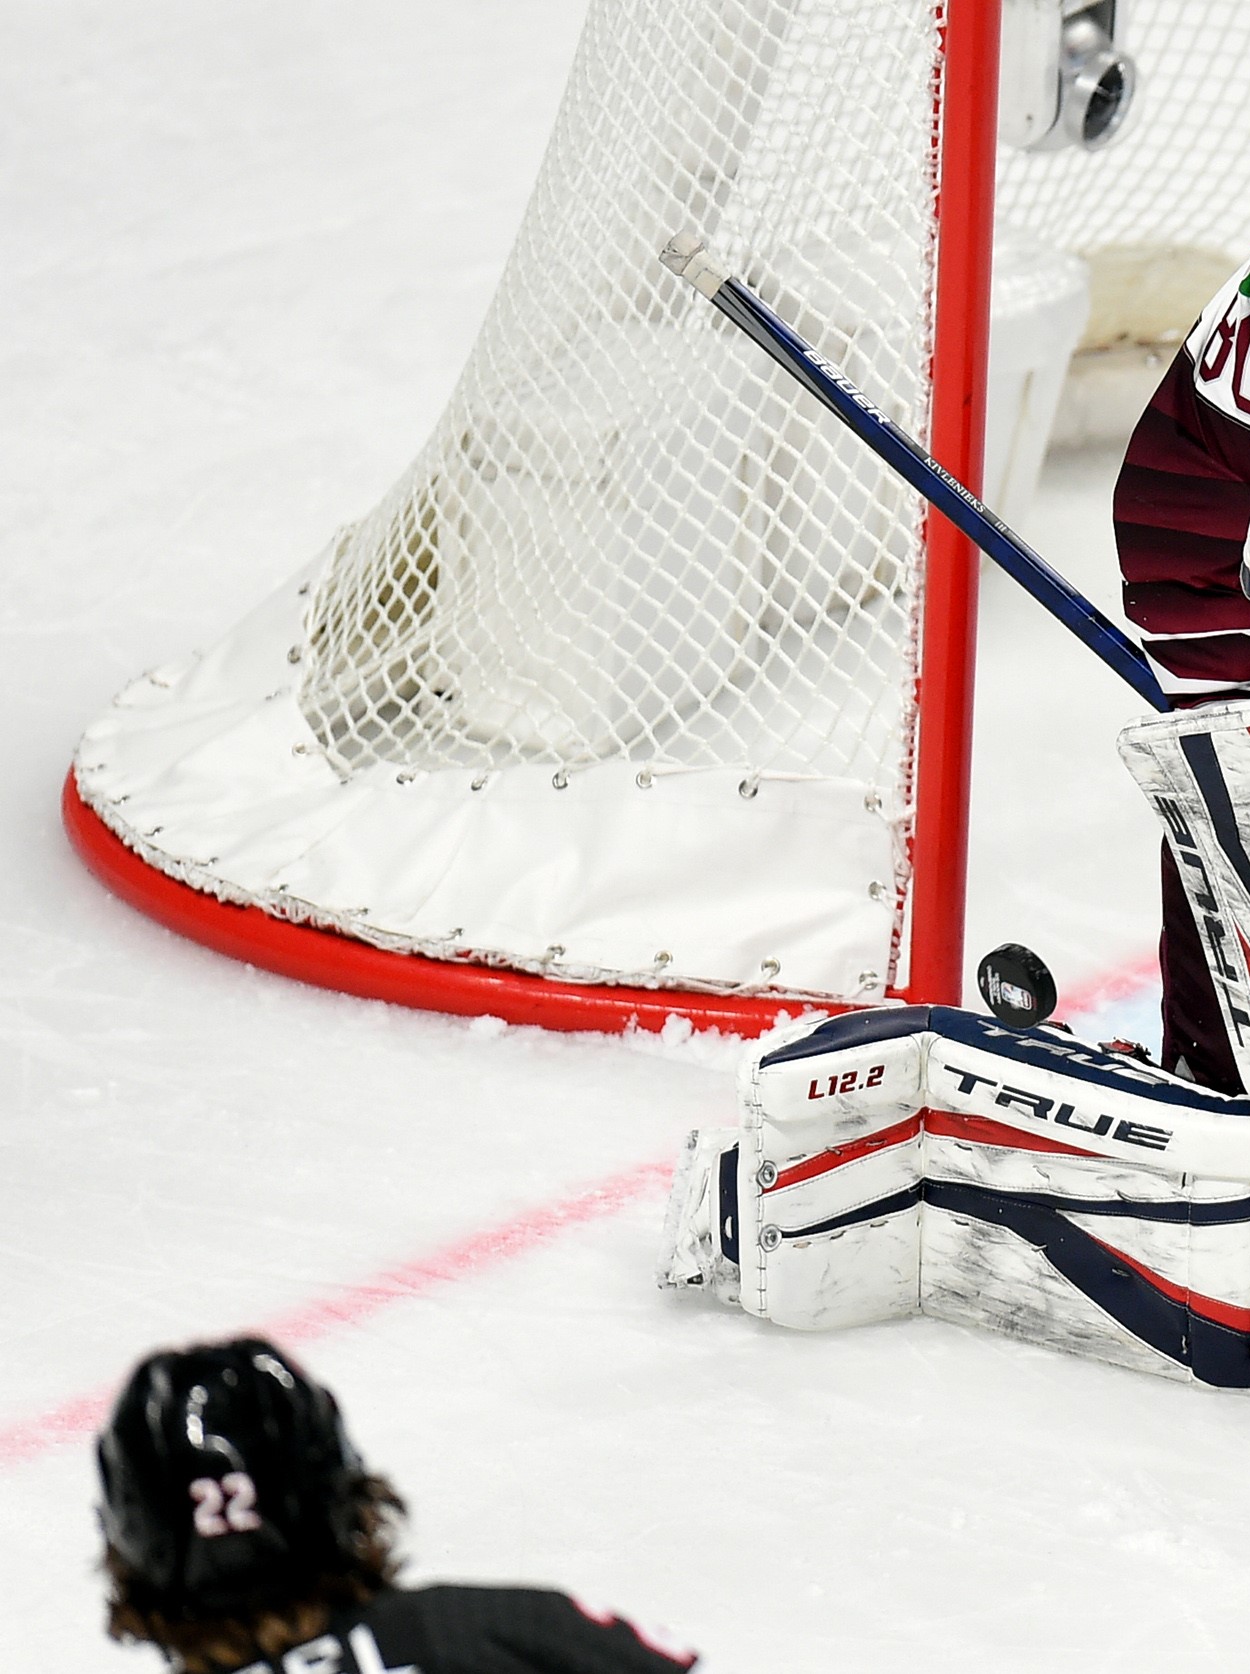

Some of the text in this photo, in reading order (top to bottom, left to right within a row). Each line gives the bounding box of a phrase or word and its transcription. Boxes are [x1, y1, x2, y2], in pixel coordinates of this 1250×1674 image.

[803, 350, 891, 424] BAUER
[923, 456, 986, 513] KIVLENIEKS
[808, 1064, 885, 1100] L12.2
[944, 1064, 1174, 1151] TRUE
[189, 1471, 262, 1537] 22
